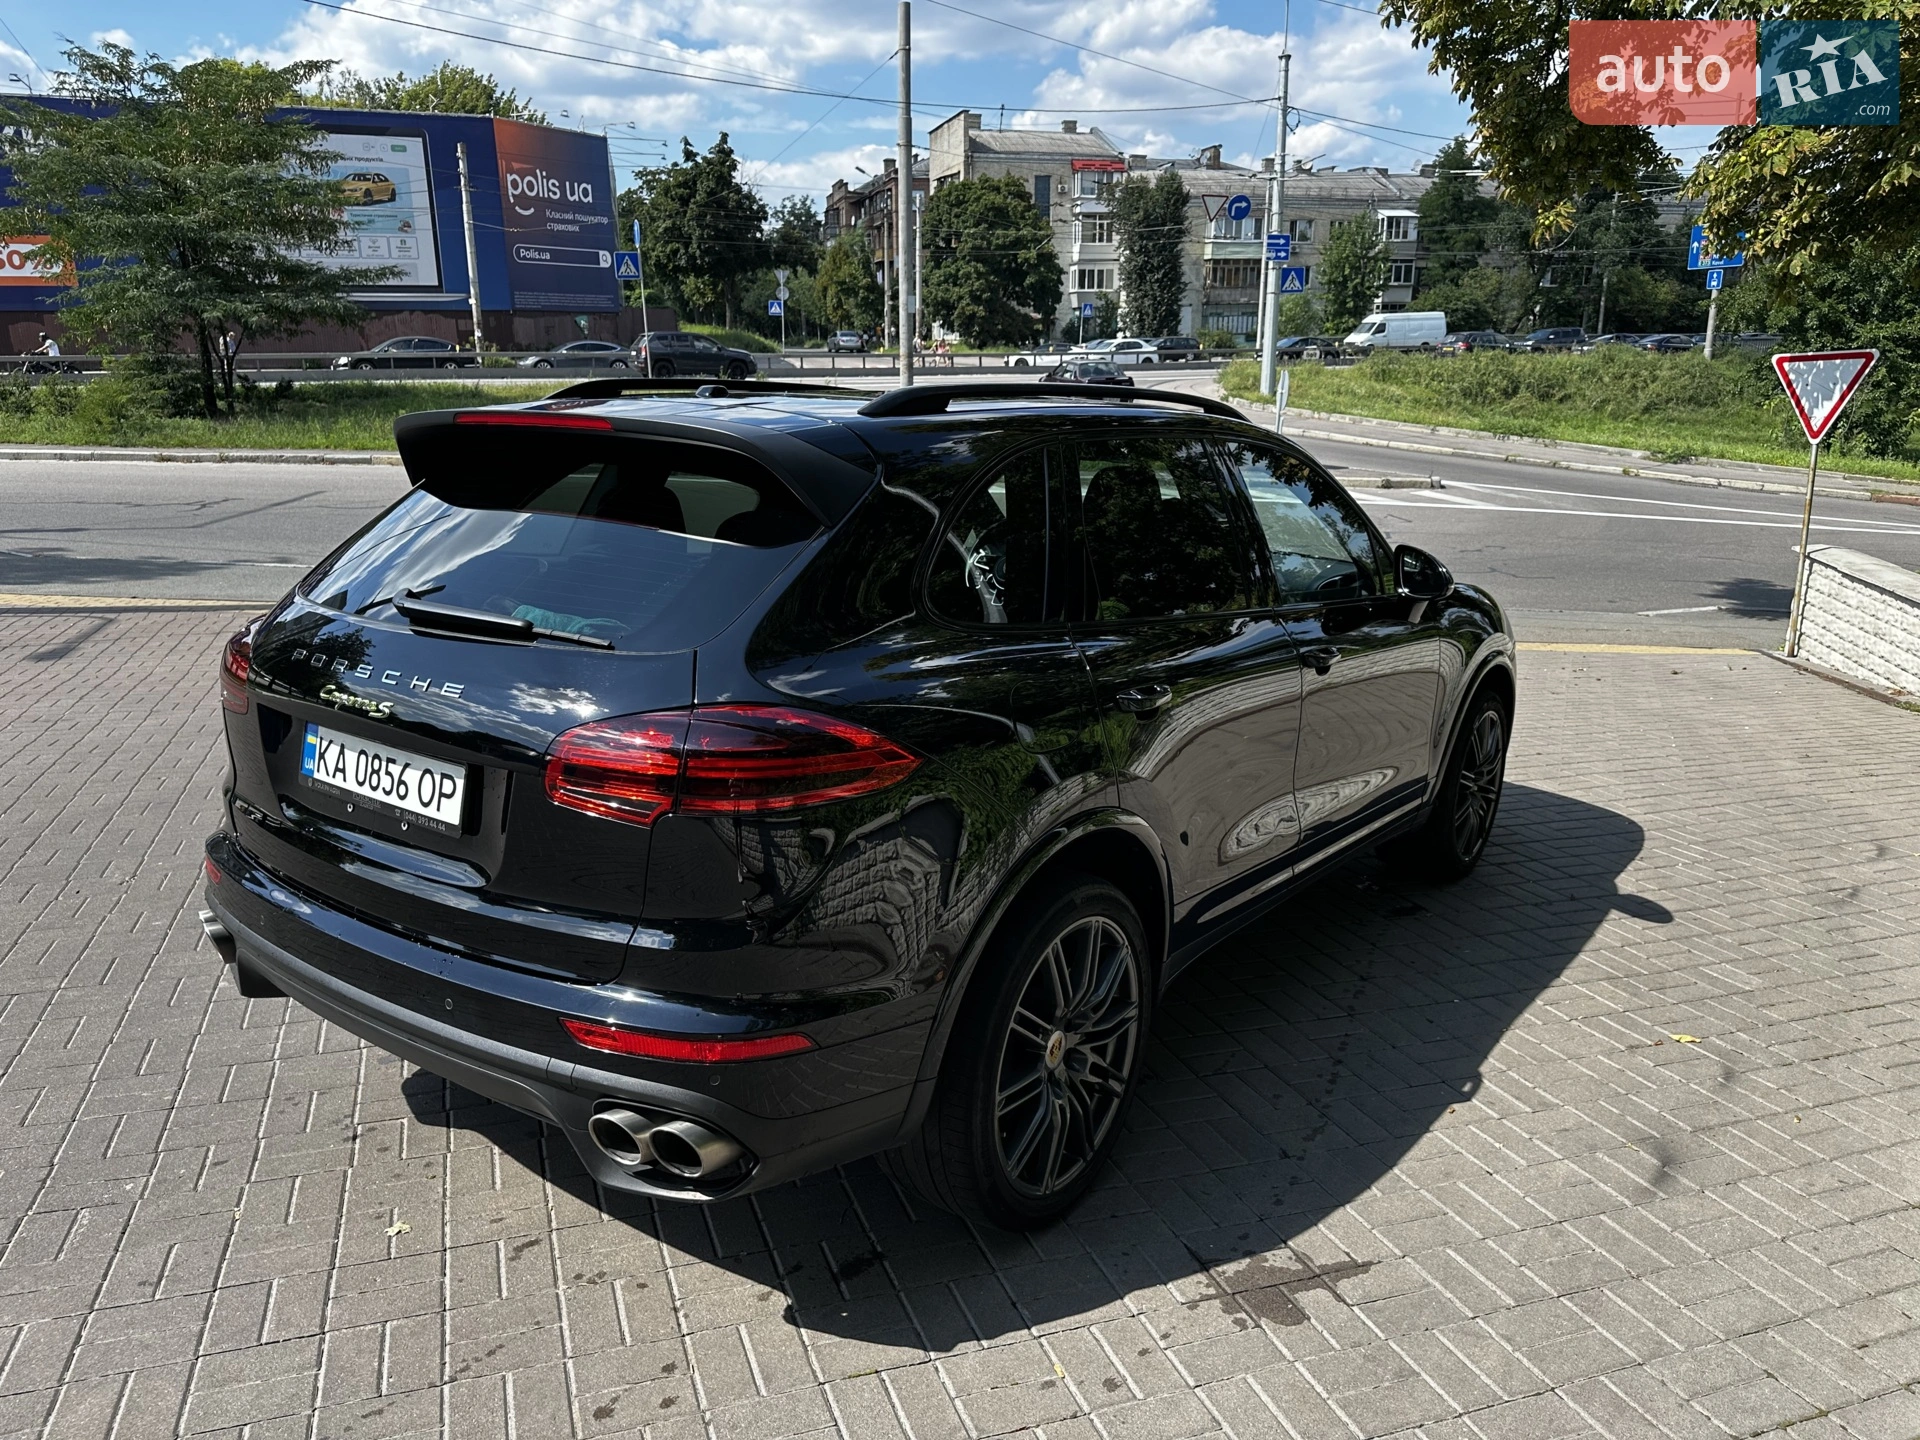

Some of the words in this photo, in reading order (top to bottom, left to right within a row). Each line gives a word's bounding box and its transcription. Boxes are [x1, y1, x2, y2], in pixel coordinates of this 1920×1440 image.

[507, 169, 560, 203] polis
[566, 181, 593, 203] ua
[545, 209, 574, 221] Класний
[575, 212, 609, 225] пошукатор
[546, 222, 580, 232] страхових
[519, 249, 551, 260] Polis.ua
[291, 648, 465, 698] PORSCHE
[319, 685, 378, 711] Cayenne
[368, 701, 394, 719] S
[305, 757, 314, 771] UA
[316, 736, 347, 783] KA
[355, 749, 411, 801] 0856
[418, 768, 457, 812] OP
[418, 816, 429, 827] 393
[429, 820, 437, 829] 44
[438, 823, 446, 832] 44
